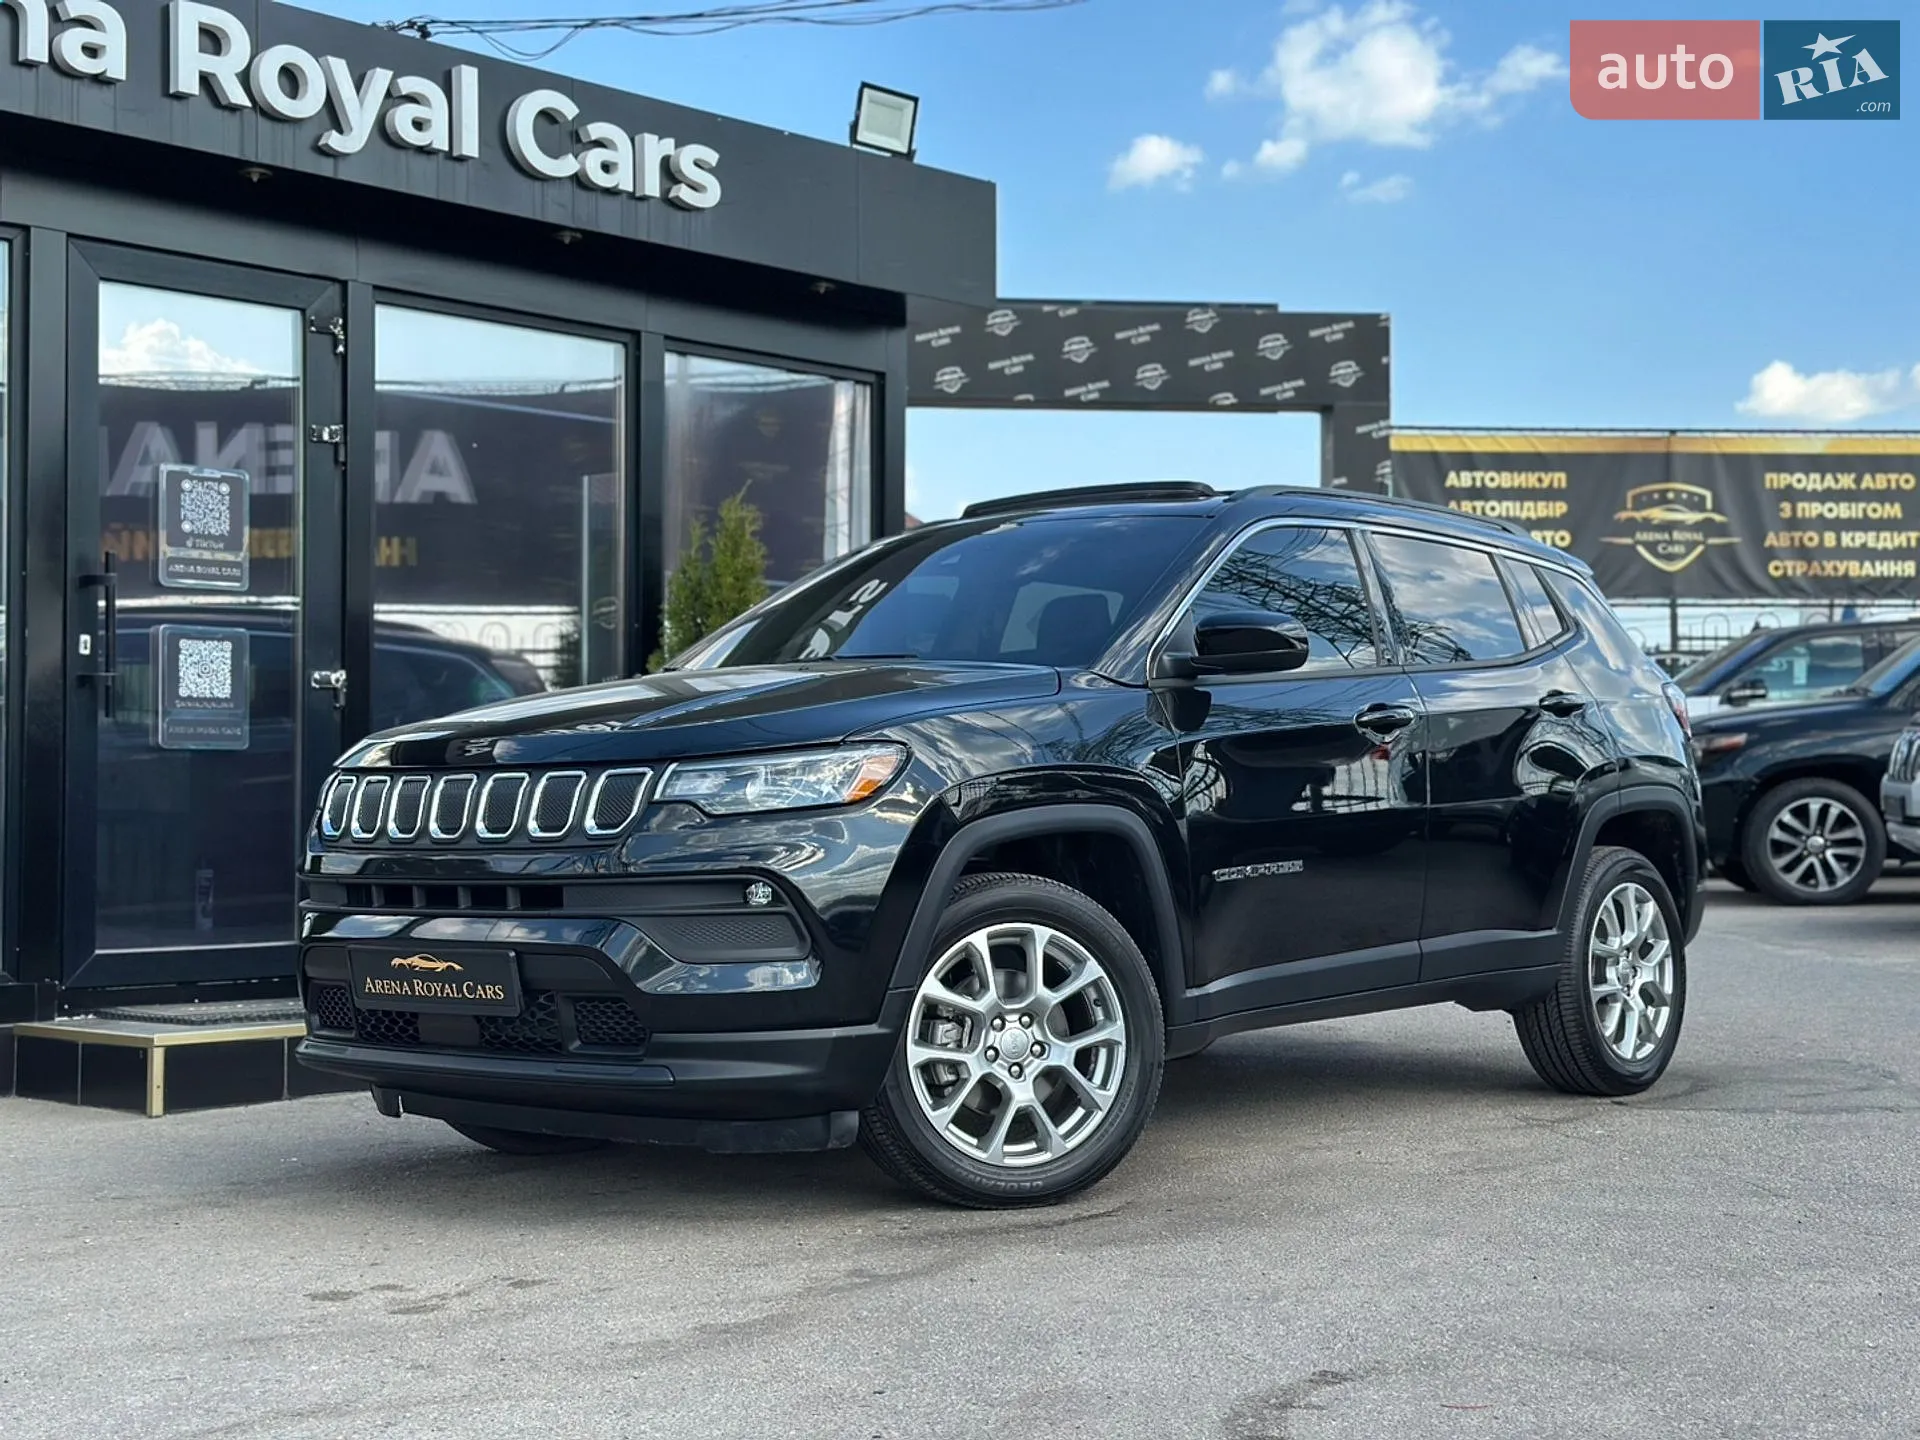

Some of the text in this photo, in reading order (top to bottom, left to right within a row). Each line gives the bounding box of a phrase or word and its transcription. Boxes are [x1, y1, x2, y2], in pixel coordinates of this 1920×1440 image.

[169, 0, 479, 160] Royal
[506, 89, 722, 209] Cars
[1444, 470, 1568, 489] АВТОВИКУП
[1764, 472, 1916, 492] ПРОДАЖ АВТО
[1796, 501, 1903, 519] ПРОБІГОМ
[1763, 531, 1920, 550] АВТО В КРЕДИТ
[1767, 559, 1917, 578] СТРАХУВАННЯ
[365, 976, 505, 1000] ARENA ROYAL CARS
